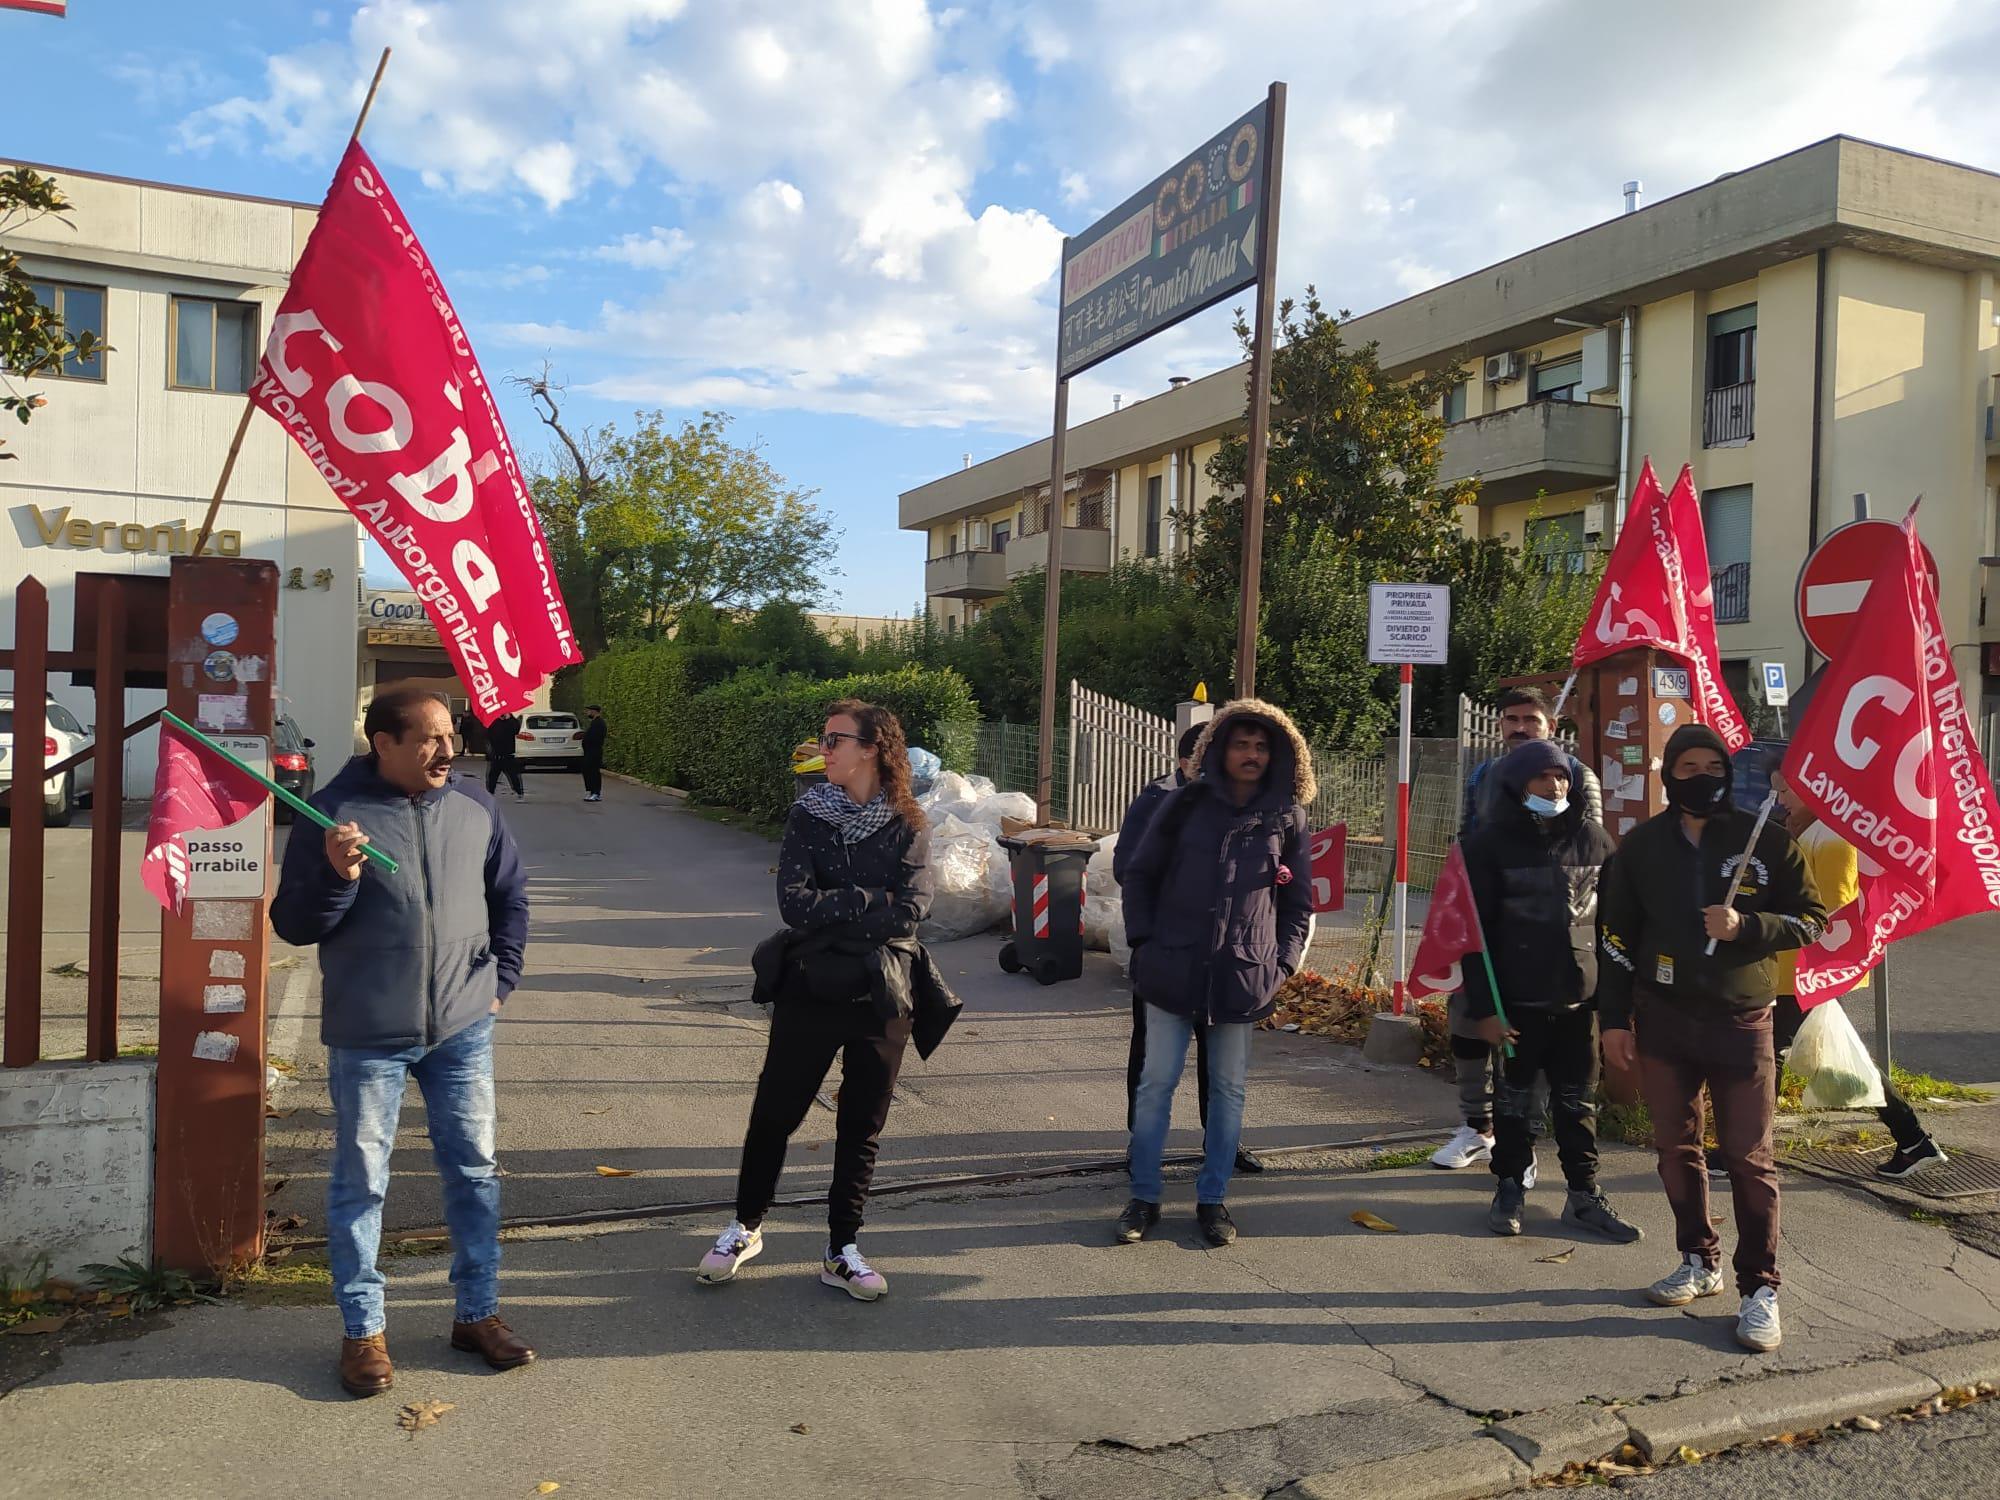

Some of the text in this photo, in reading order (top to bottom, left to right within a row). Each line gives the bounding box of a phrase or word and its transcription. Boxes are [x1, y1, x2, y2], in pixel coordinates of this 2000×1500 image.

[1155, 123, 1258, 230] COCO
[1174, 195, 1228, 250] ITALIA
[1067, 214, 1151, 296] MAGLIFICIO
[1140, 233, 1239, 323] Pronto Moda
[360, 499, 509, 715] Autorganizzati
[371, 598, 413, 619] Coco
[1386, 625, 1431, 633] DIVIETO DI
[1390, 633, 1427, 641] SCARICO
[1659, 673, 1686, 690] 43/9
[1769, 668, 1780, 686] P
[233, 741, 260, 749] Prato
[1798, 752, 1935, 877] Lavoratori
[188, 842, 243, 855] passo
[190, 858, 258, 872] rrabile
